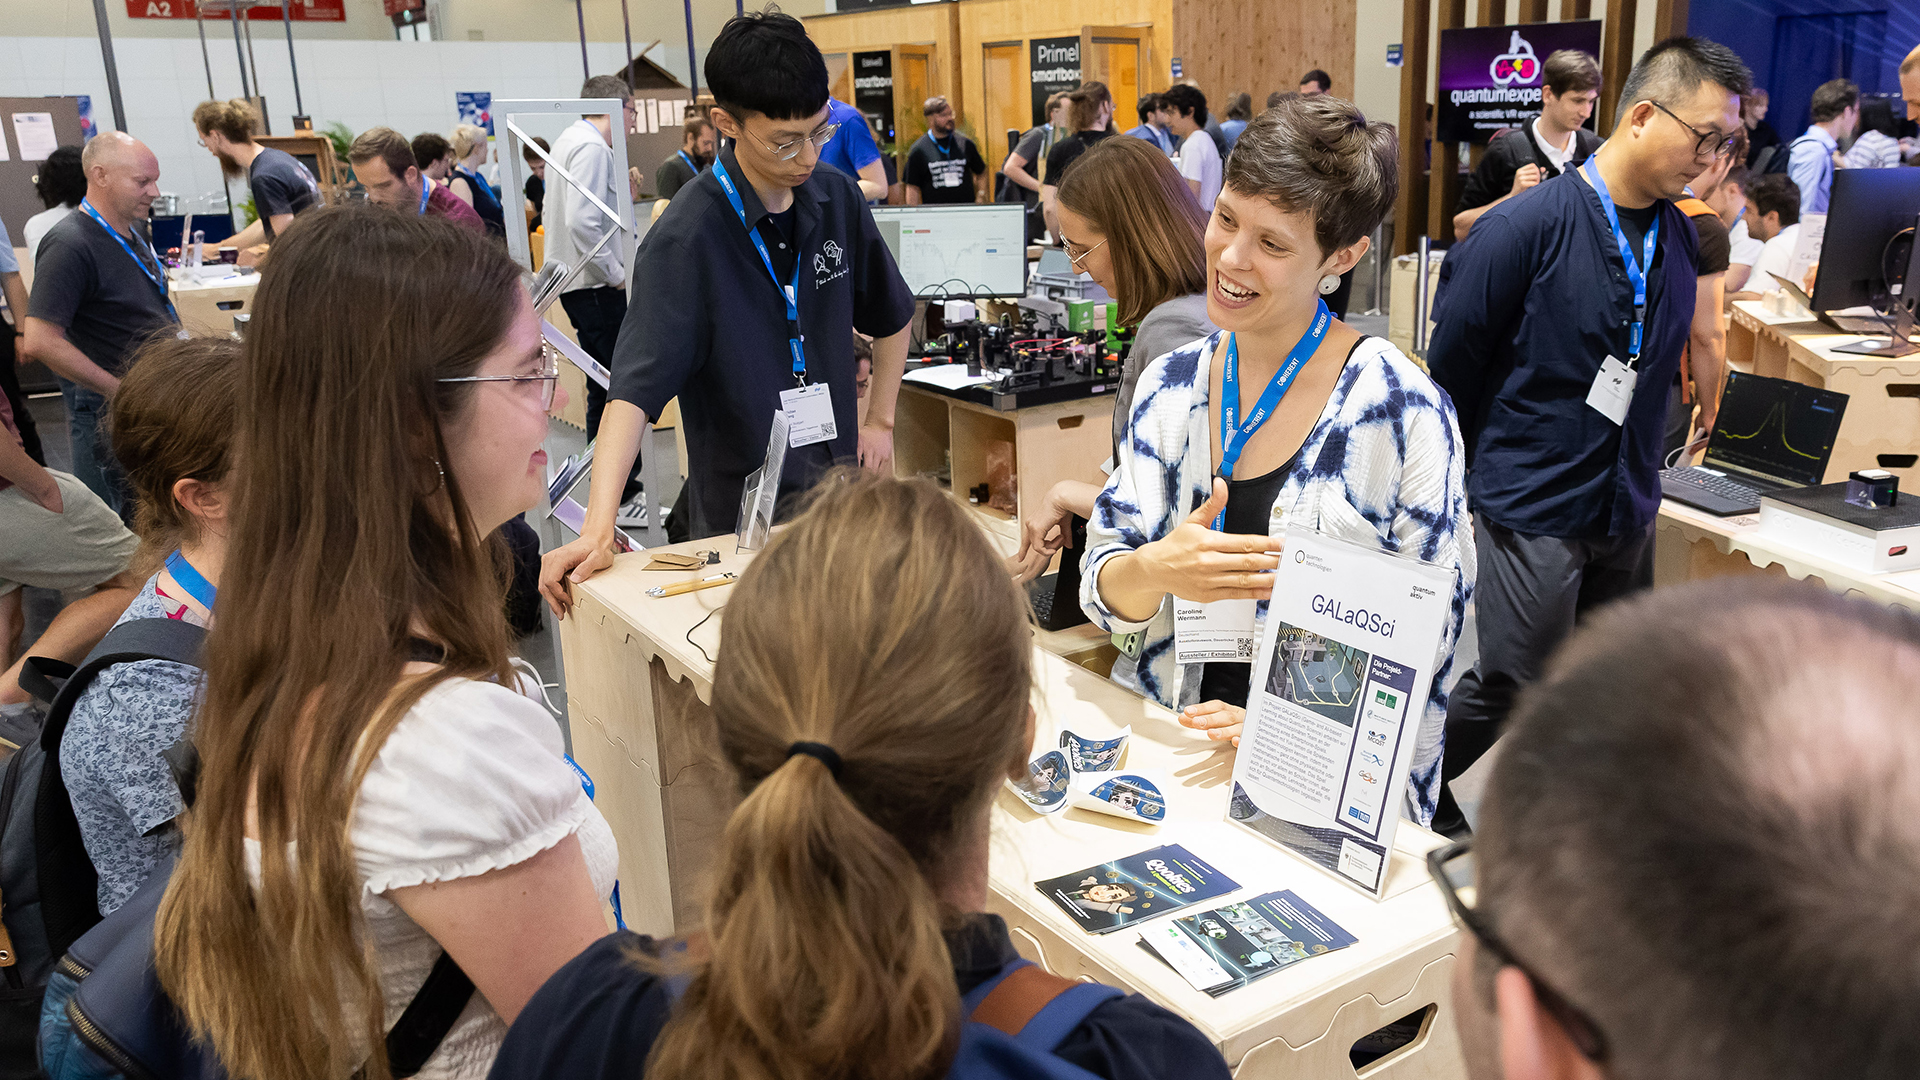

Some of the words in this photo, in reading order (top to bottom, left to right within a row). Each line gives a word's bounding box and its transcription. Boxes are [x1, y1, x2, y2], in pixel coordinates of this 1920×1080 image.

[146, 1, 173, 17] A2
[1038, 42, 1079, 63] Primel
[1312, 312, 1326, 338] COHERENT
[1277, 357, 1300, 386] COHERENT
[1243, 408, 1266, 434] COHERENT
[1306, 554, 1323, 562] quanten
[1306, 561, 1332, 572] technologien
[1410, 592, 1423, 600] aktiv
[1413, 585, 1436, 596] quantum
[1312, 594, 1396, 638] GALaQSci
[1372, 668, 1392, 680] Partner:
[1374, 659, 1382, 668] Die
[1383, 663, 1402, 674] Projekt-
[1258, 719, 1280, 733] Entwicklung
[1280, 729, 1290, 737] eines
[1261, 706, 1277, 717] Learning
[1277, 713, 1288, 721] about
[1288, 718, 1305, 730] Quantum
[1306, 726, 1323, 738] Science)
[1323, 733, 1339, 744] arbeiten
[1263, 714, 1275, 723] einem
[1306, 733, 1317, 741] Team
[1268, 701, 1281, 712] Projekt
[1324, 726, 1342, 737] AI-based
[1255, 732, 1293, 754] Quantentechnologien
[1309, 757, 1321, 766] indem
[1257, 726, 1278, 739] Gemeinsam
[1293, 742, 1306, 751] lernen
[1312, 751, 1334, 765] Spielenden
[1367, 736, 1385, 747] MCQST
[1250, 758, 1259, 766] auch
[1253, 746, 1279, 762] mathematische
[1315, 775, 1326, 785] Spiel
[1289, 755, 1299, 763] ohne
[1299, 759, 1324, 776] physikalische
[1325, 771, 1334, 779] oder
[1277, 764, 1287, 773] allem
[1320, 785, 1330, 793] aber
[1145, 859, 1195, 893] Qookies
